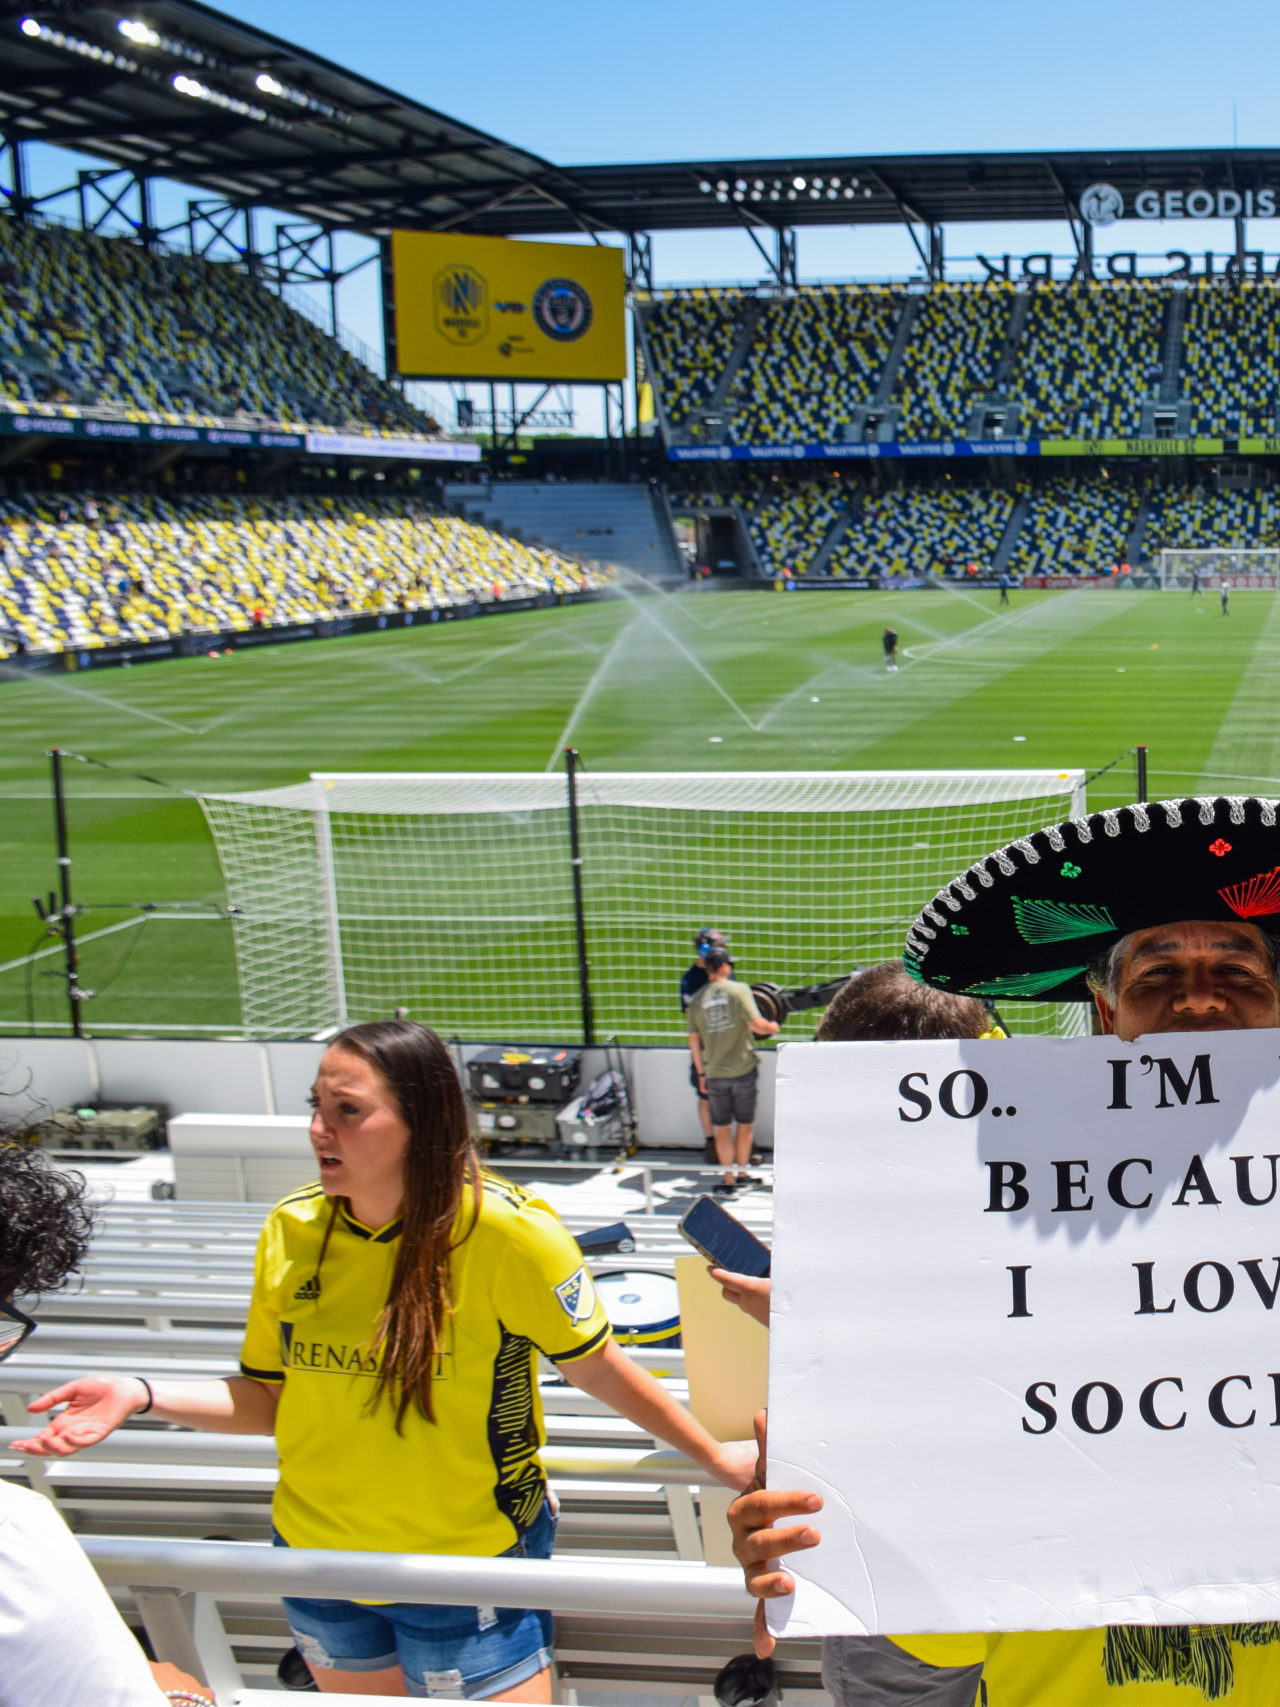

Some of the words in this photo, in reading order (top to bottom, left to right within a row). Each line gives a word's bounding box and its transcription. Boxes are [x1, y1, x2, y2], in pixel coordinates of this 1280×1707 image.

[1135, 189, 1276, 219] GEODIS
[898, 1069, 1017, 1122] SO..
[1106, 1053, 1220, 1110] I’M
[561, 1280, 580, 1299] MLS
[1006, 1265, 1033, 1318] I
